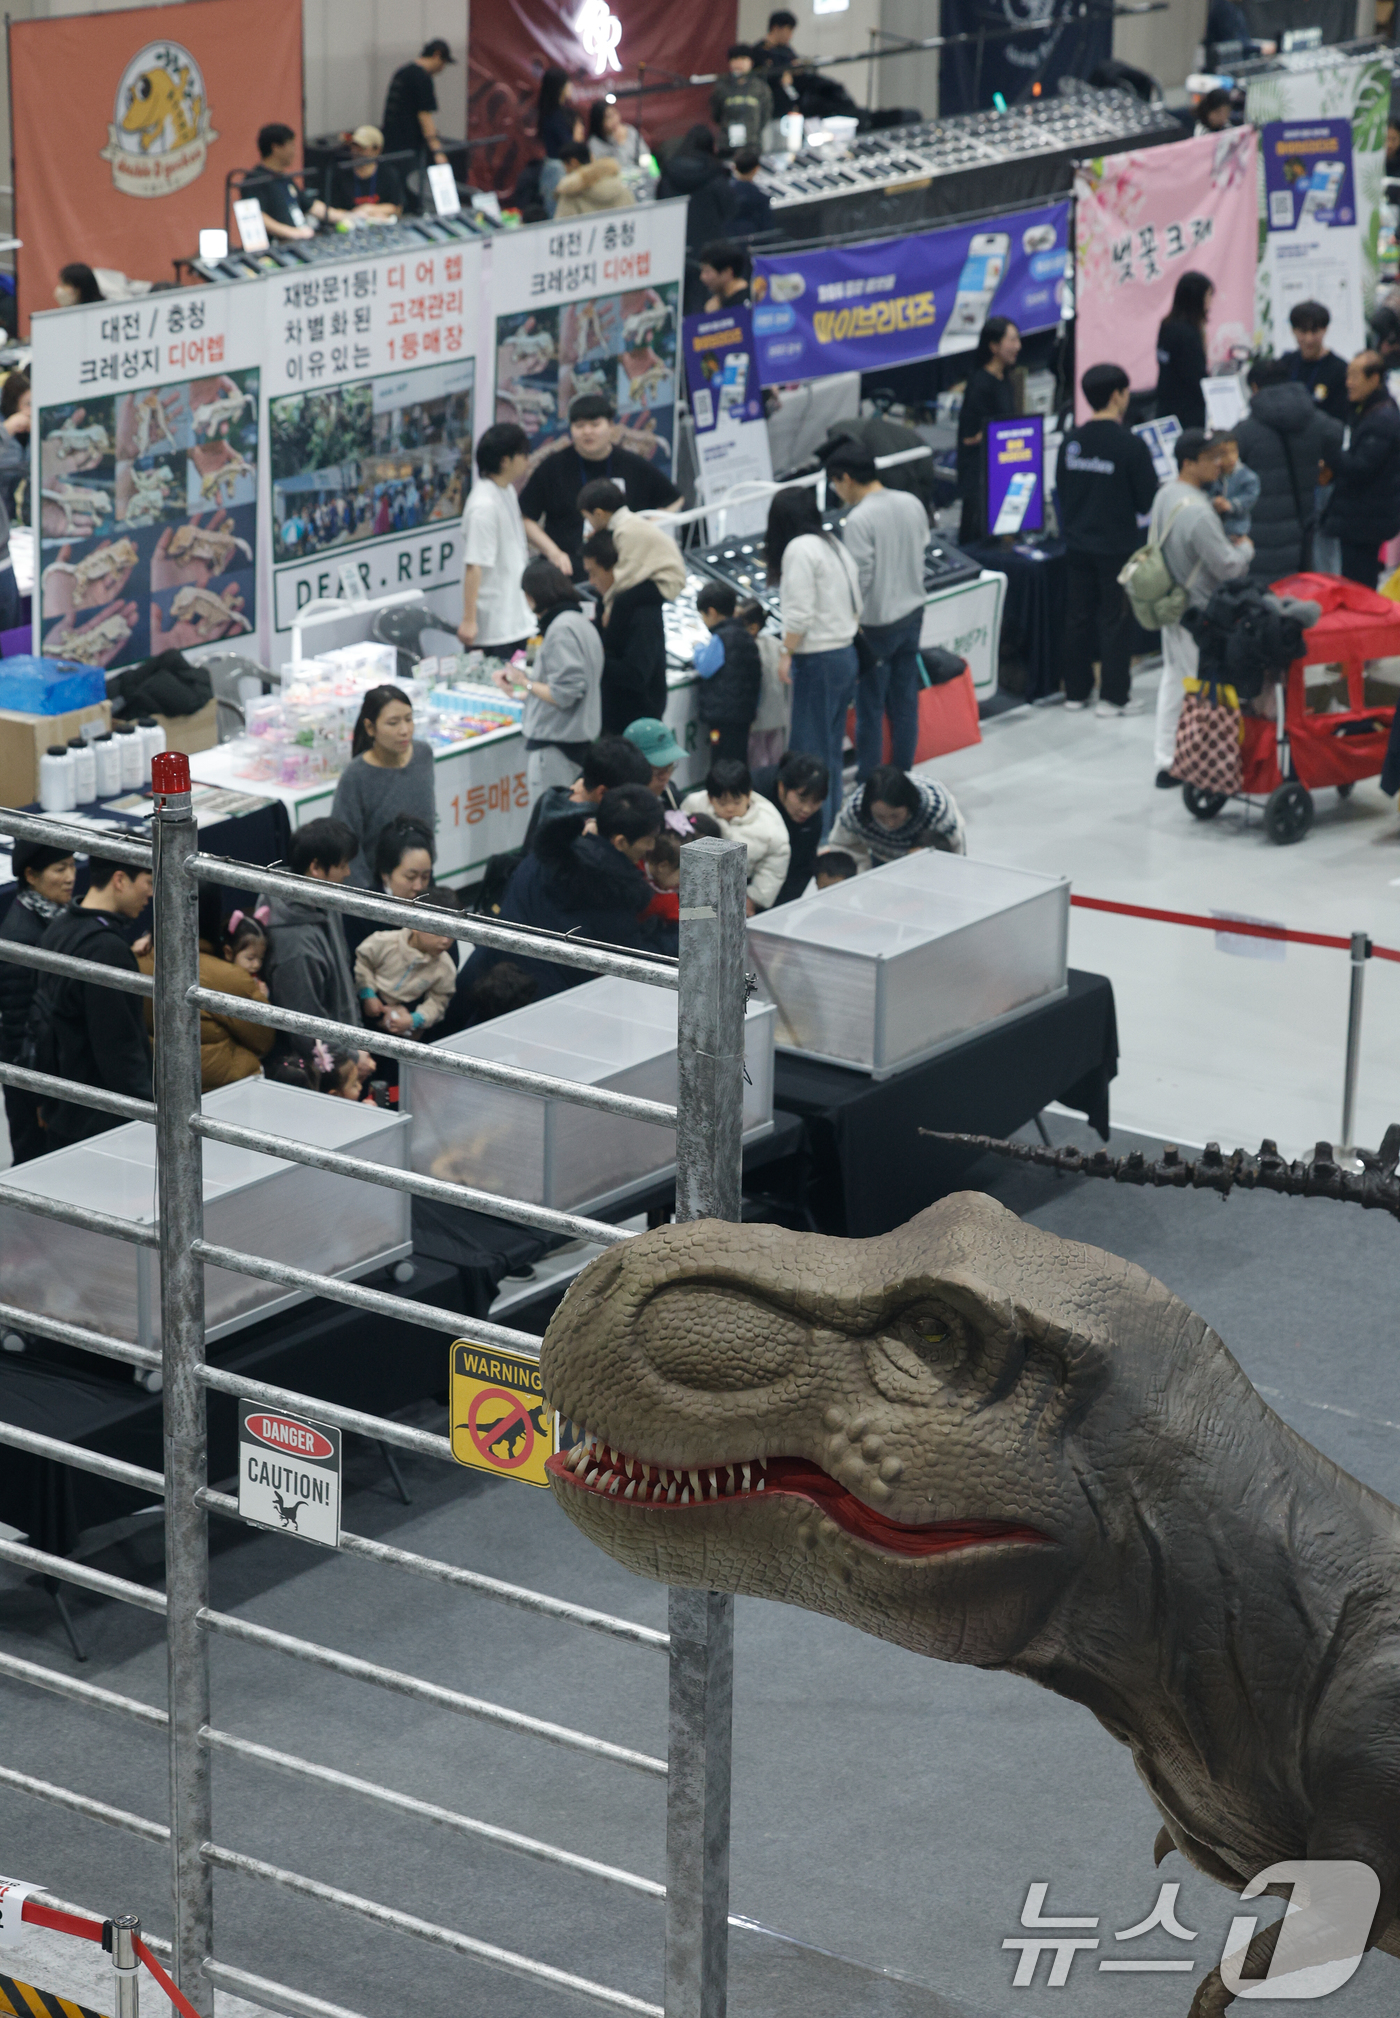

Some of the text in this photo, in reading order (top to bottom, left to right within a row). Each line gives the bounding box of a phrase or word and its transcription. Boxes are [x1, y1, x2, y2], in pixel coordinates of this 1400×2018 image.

[550, 220, 636, 258] 대전 / 충청
[283, 268, 378, 308] 재방문1등!
[530, 261, 598, 296] 크레성지
[101, 300, 206, 343] 대전 / 충청
[388, 289, 464, 326] 고객관리
[387, 324, 464, 361] 1등매장
[79, 346, 160, 384] 크레성지
[463, 1352, 543, 1390] WARNING
[262, 1418, 315, 1453] DANGER
[247, 1457, 330, 1507] CAUTION!
